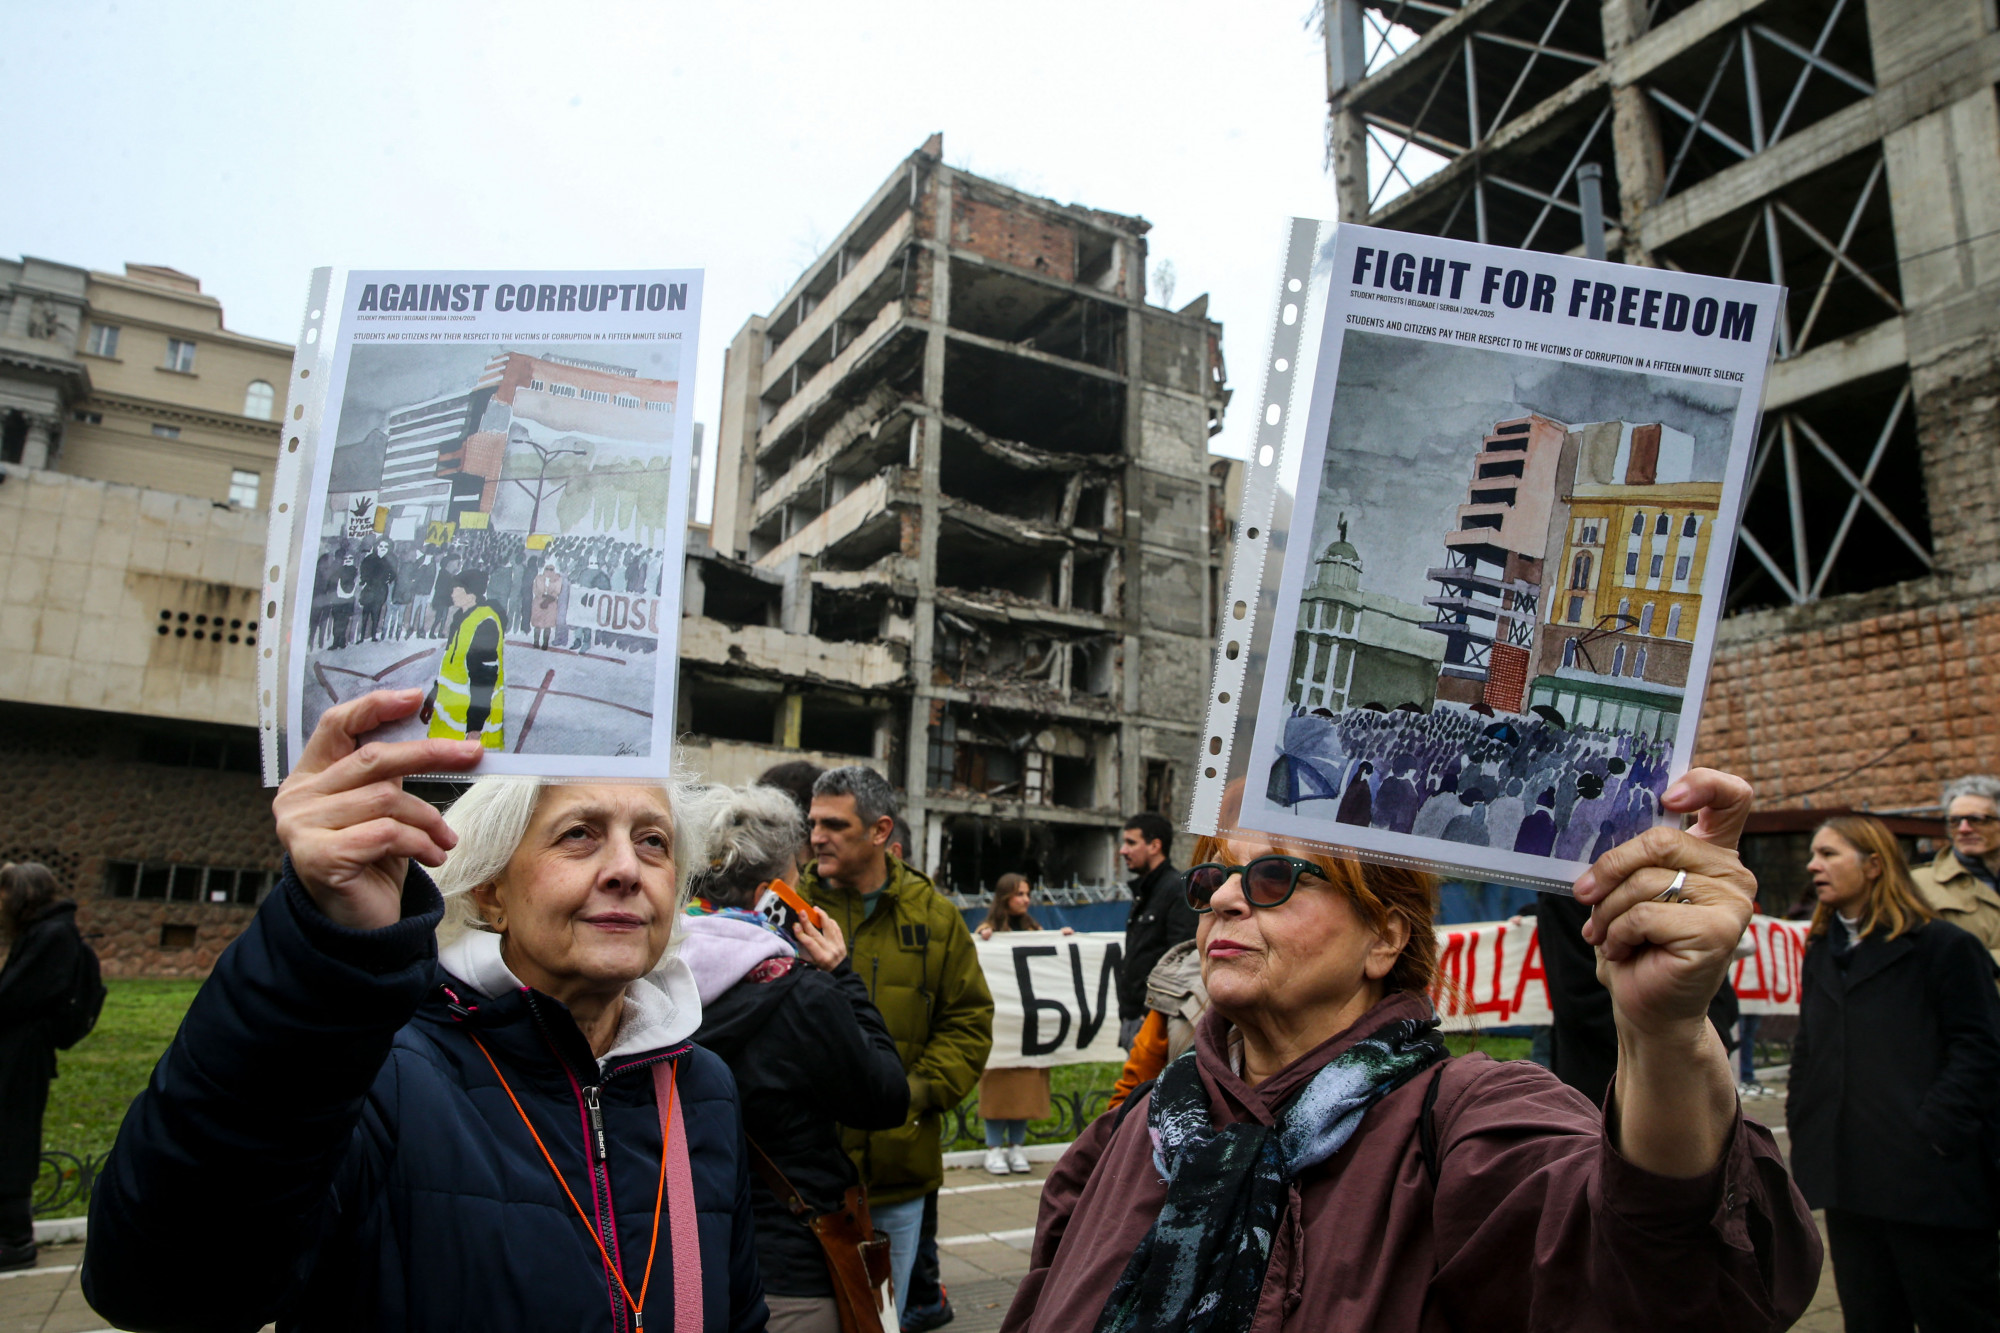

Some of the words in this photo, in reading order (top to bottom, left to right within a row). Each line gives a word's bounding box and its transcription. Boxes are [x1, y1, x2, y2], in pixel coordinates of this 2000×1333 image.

[358, 284, 490, 312] AGAINST
[495, 283, 688, 312] CORRUPTION
[1350, 290, 1375, 300] STUDENT
[1376, 294, 1404, 305] PROTESTS
[1408, 299, 1435, 309] BELGRADE
[1440, 303, 1459, 312] SERBIA
[1463, 307, 1495, 318] 2024/2025
[1352, 246, 1471, 300] FIGHT
[1480, 266, 1556, 313] FOR
[1568, 279, 1758, 342] FREEDOM
[353, 332, 385, 340] STUDENTS
[387, 332, 400, 340] AND
[401, 332, 429, 340] CITIZENS
[430, 332, 442, 340] PAY
[443, 332, 461, 340] THEIR
[463, 332, 490, 340] RESPECT
[491, 332, 499, 340] TO
[501, 332, 513, 340] THE
[514, 332, 540, 340] VICTIMS
[541, 332, 550, 340] OF
[551, 332, 592, 340] CORRUPTION
[593, 332, 601, 340] IN
[602, 332, 607, 340] A
[608, 332, 631, 340] FIFTEEN
[632, 332, 656, 340] MINUTE
[657, 332, 683, 340] SILENCE
[1346, 314, 1385, 328] STUDENTS
[1386, 320, 1402, 331] AND
[1404, 323, 1437, 336] CITIZENS
[1438, 328, 1453, 339] PAY
[1455, 330, 1476, 342] THEIR
[1478, 334, 1511, 347] RESPECT
[1513, 338, 1522, 349] TO
[1524, 341, 1539, 352] THE
[1540, 343, 1571, 357] VICTIMS
[1573, 348, 1583, 358] OF
[1585, 350, 1633, 366] CORRUPTION
[1635, 357, 1644, 367] IN
[1645, 359, 1651, 369] A
[1653, 360, 1681, 373] FIFTEEN
[1682, 364, 1712, 377] MINUTE
[1713, 369, 1745, 382] SILENCE
